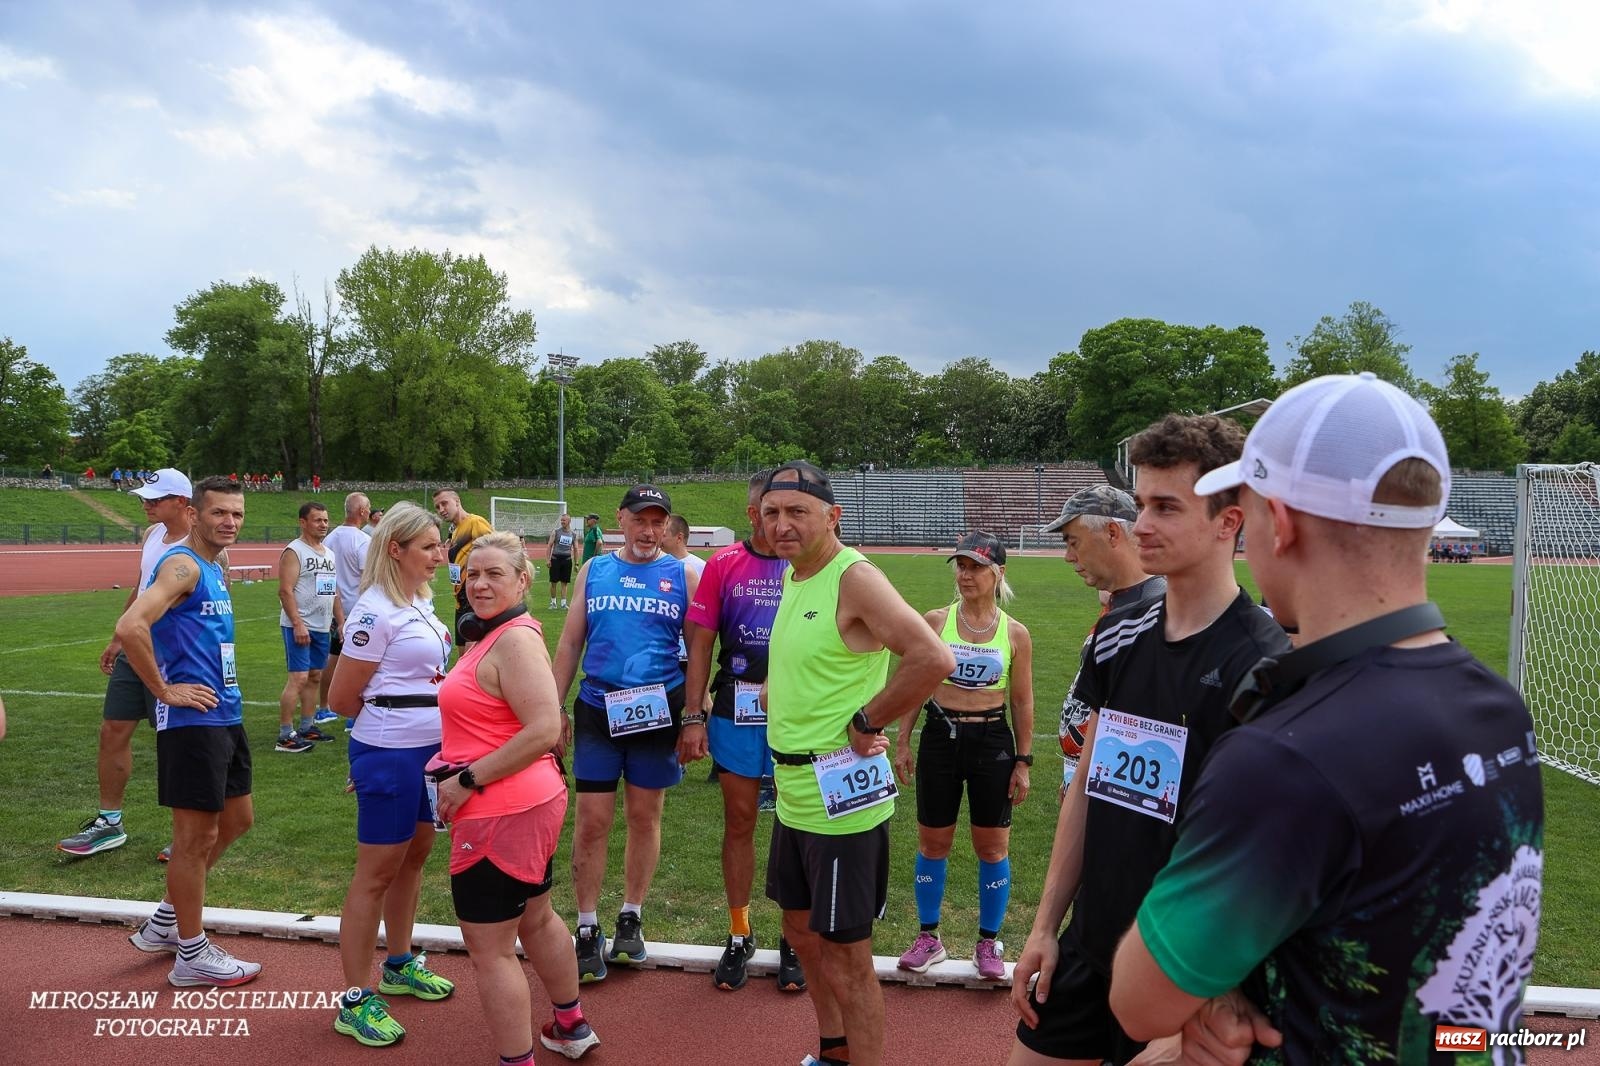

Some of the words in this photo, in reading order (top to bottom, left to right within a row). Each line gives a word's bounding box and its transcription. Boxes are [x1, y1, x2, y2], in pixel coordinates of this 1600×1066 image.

[640, 489, 662, 499] FILA
[748, 579, 767, 587] RUN
[745, 587, 784, 598] SILESIA
[587, 595, 681, 620] RUNNERS
[804, 610, 818, 620] 4F
[957, 662, 987, 679] 157
[624, 703, 656, 721] 261
[1105, 725, 1110, 733] 3
[1125, 730, 1138, 742] 2025
[1122, 715, 1139, 728] BIEG
[1139, 720, 1154, 733] BEZ
[1153, 724, 1183, 739] GRANIC
[832, 747, 851, 759] BIEG
[1113, 750, 1161, 790] 203
[842, 764, 883, 794] 192
